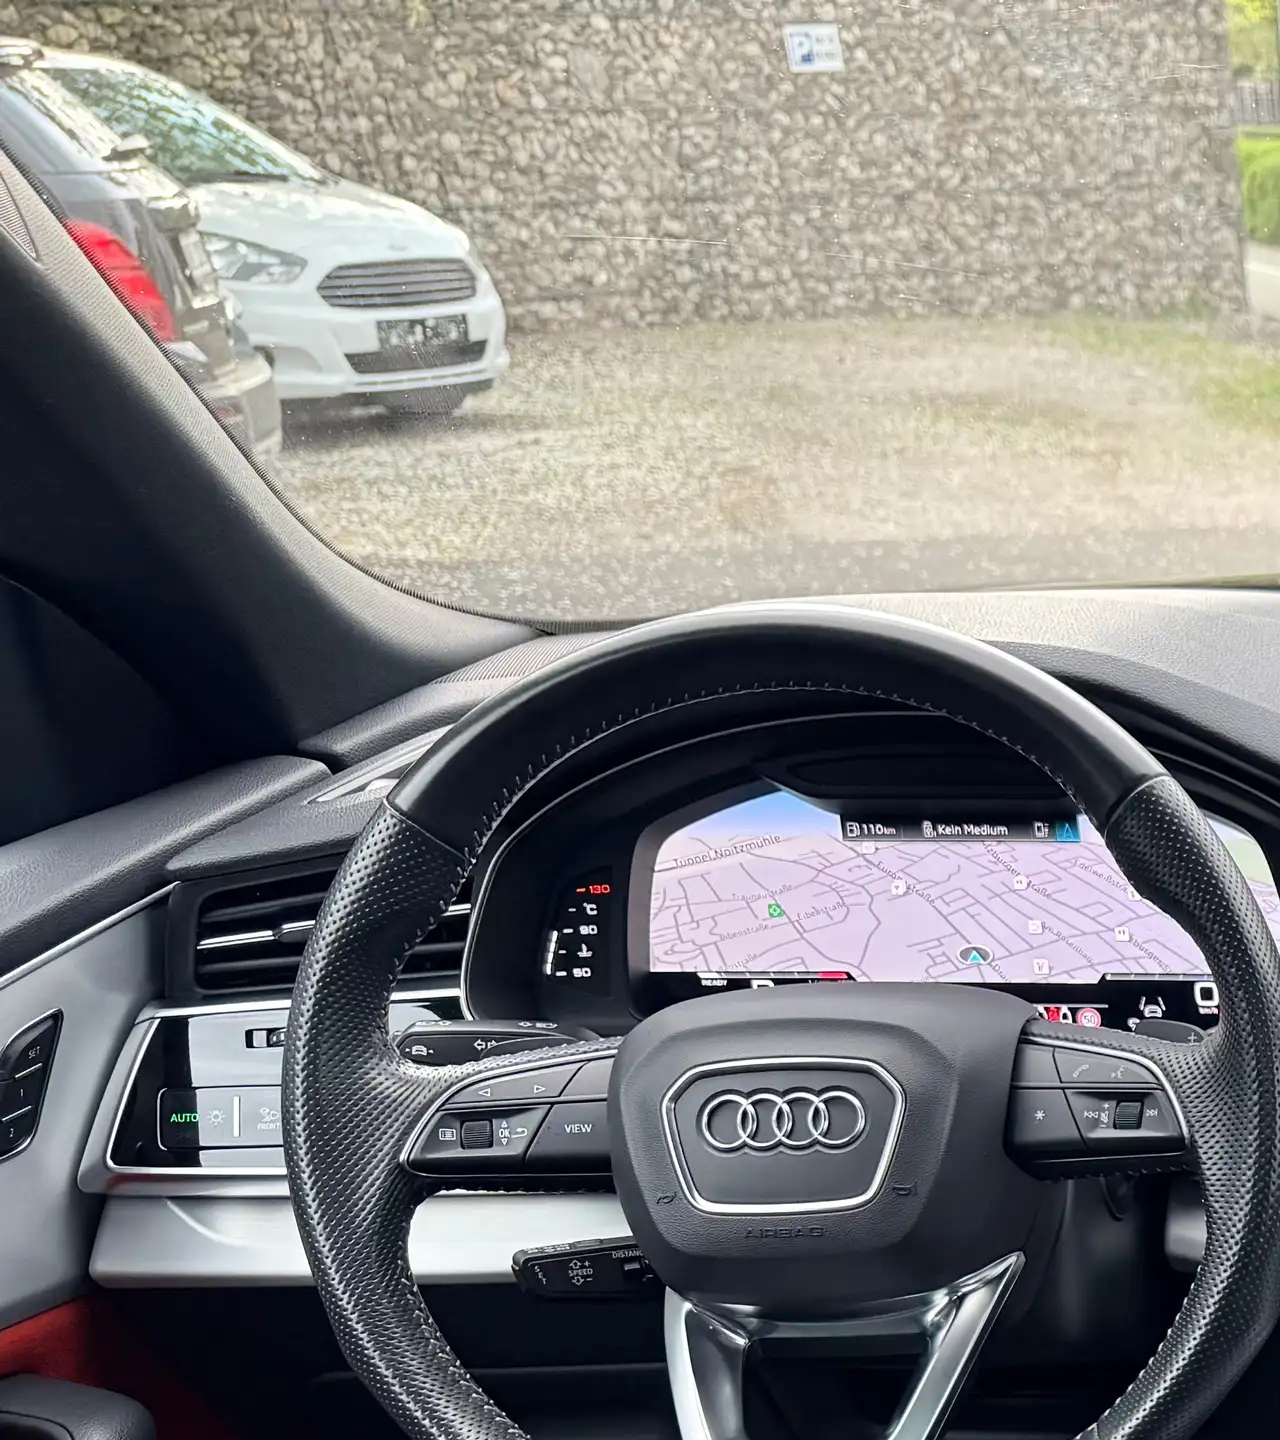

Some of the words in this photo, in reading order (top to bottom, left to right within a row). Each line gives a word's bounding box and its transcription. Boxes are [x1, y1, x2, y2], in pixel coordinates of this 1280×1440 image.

[589, 884, 611, 894] 130
[170, 1112, 199, 1123] AUTO
[498, 1128, 511, 1138] OK
[564, 1123, 592, 1134] VIEW
[568, 1267, 594, 1277] SPEED
